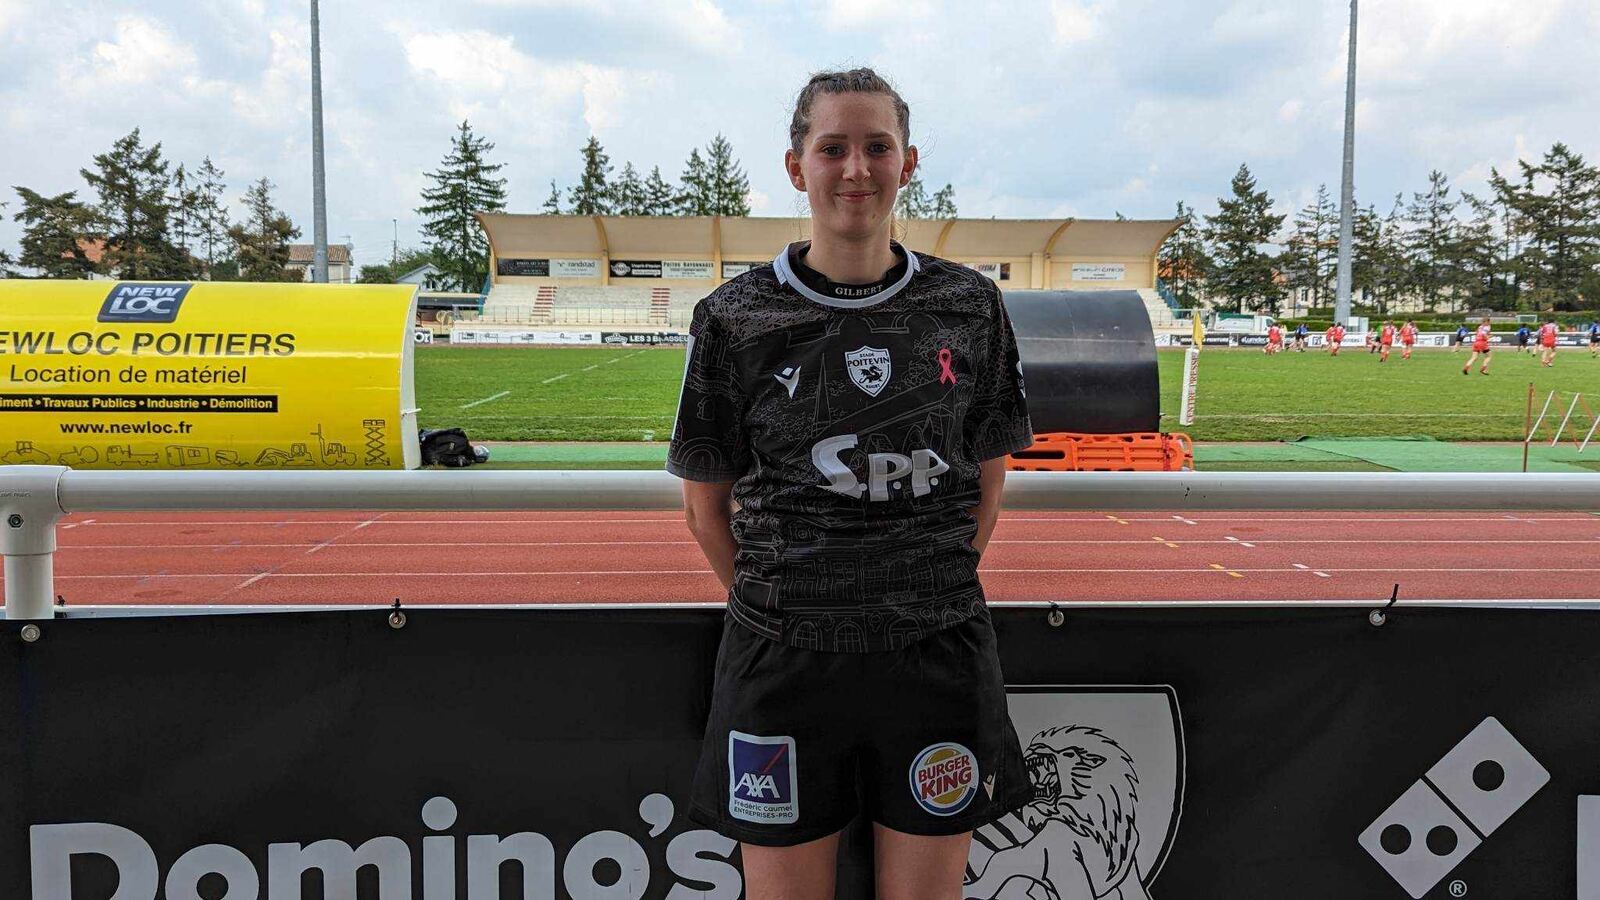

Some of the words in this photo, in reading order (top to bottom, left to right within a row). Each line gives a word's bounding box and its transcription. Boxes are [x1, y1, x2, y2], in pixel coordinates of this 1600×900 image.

[118, 287, 181, 297] NEW
[834, 284, 883, 296] GILBERT
[108, 297, 173, 314] LOC
[131, 333, 296, 356] POITIERS
[848, 357, 890, 367] POITEVIN
[10, 364, 110, 384] Location
[120, 365, 147, 384] de
[154, 365, 247, 384] matériel
[43, 397, 89, 408] Travaux
[92, 397, 136, 409] Publics
[147, 397, 199, 409] Industrie
[209, 396, 273, 409] Démolition
[60, 420, 192, 434] www.newloc.fr
[918, 755, 971, 783] BURGER
[734, 772, 781, 799] AXA
[921, 766, 972, 800] KING
